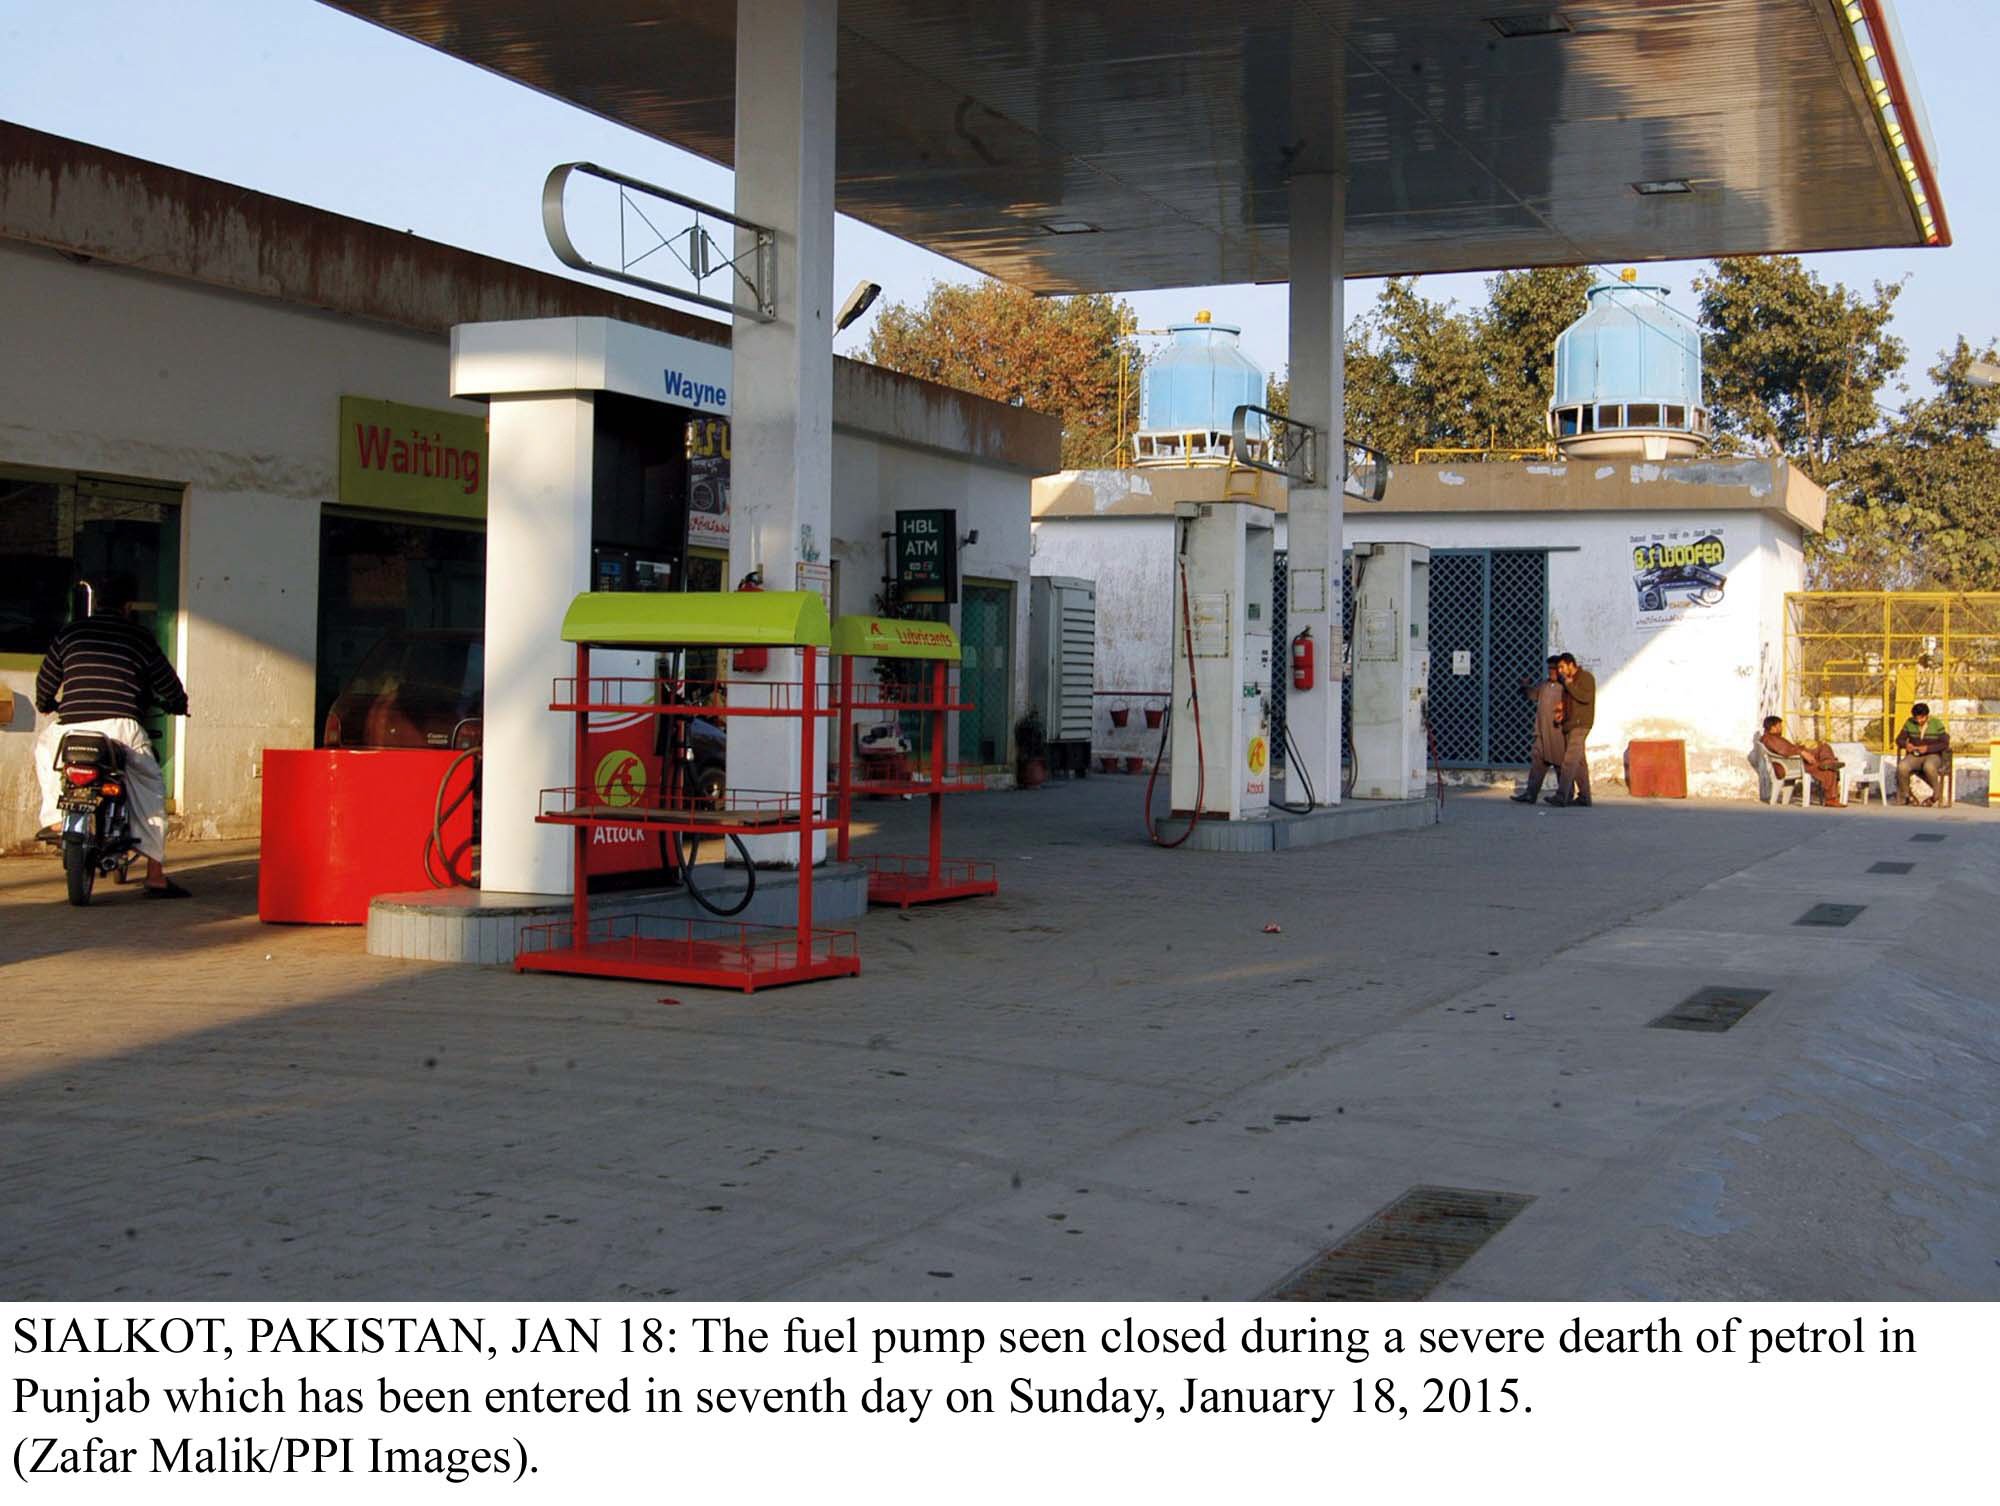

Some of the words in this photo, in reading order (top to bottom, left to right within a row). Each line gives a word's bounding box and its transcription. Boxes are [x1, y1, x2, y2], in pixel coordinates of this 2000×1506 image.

[664, 369, 726, 406] Wayne
[356, 423, 480, 494] Waiting
[903, 519, 938, 533] HBL
[905, 540, 938, 555] ATM
[1659, 542, 1722, 568] WOOFER
[896, 626, 953, 648] Lubricants
[593, 826, 646, 845] Attock
